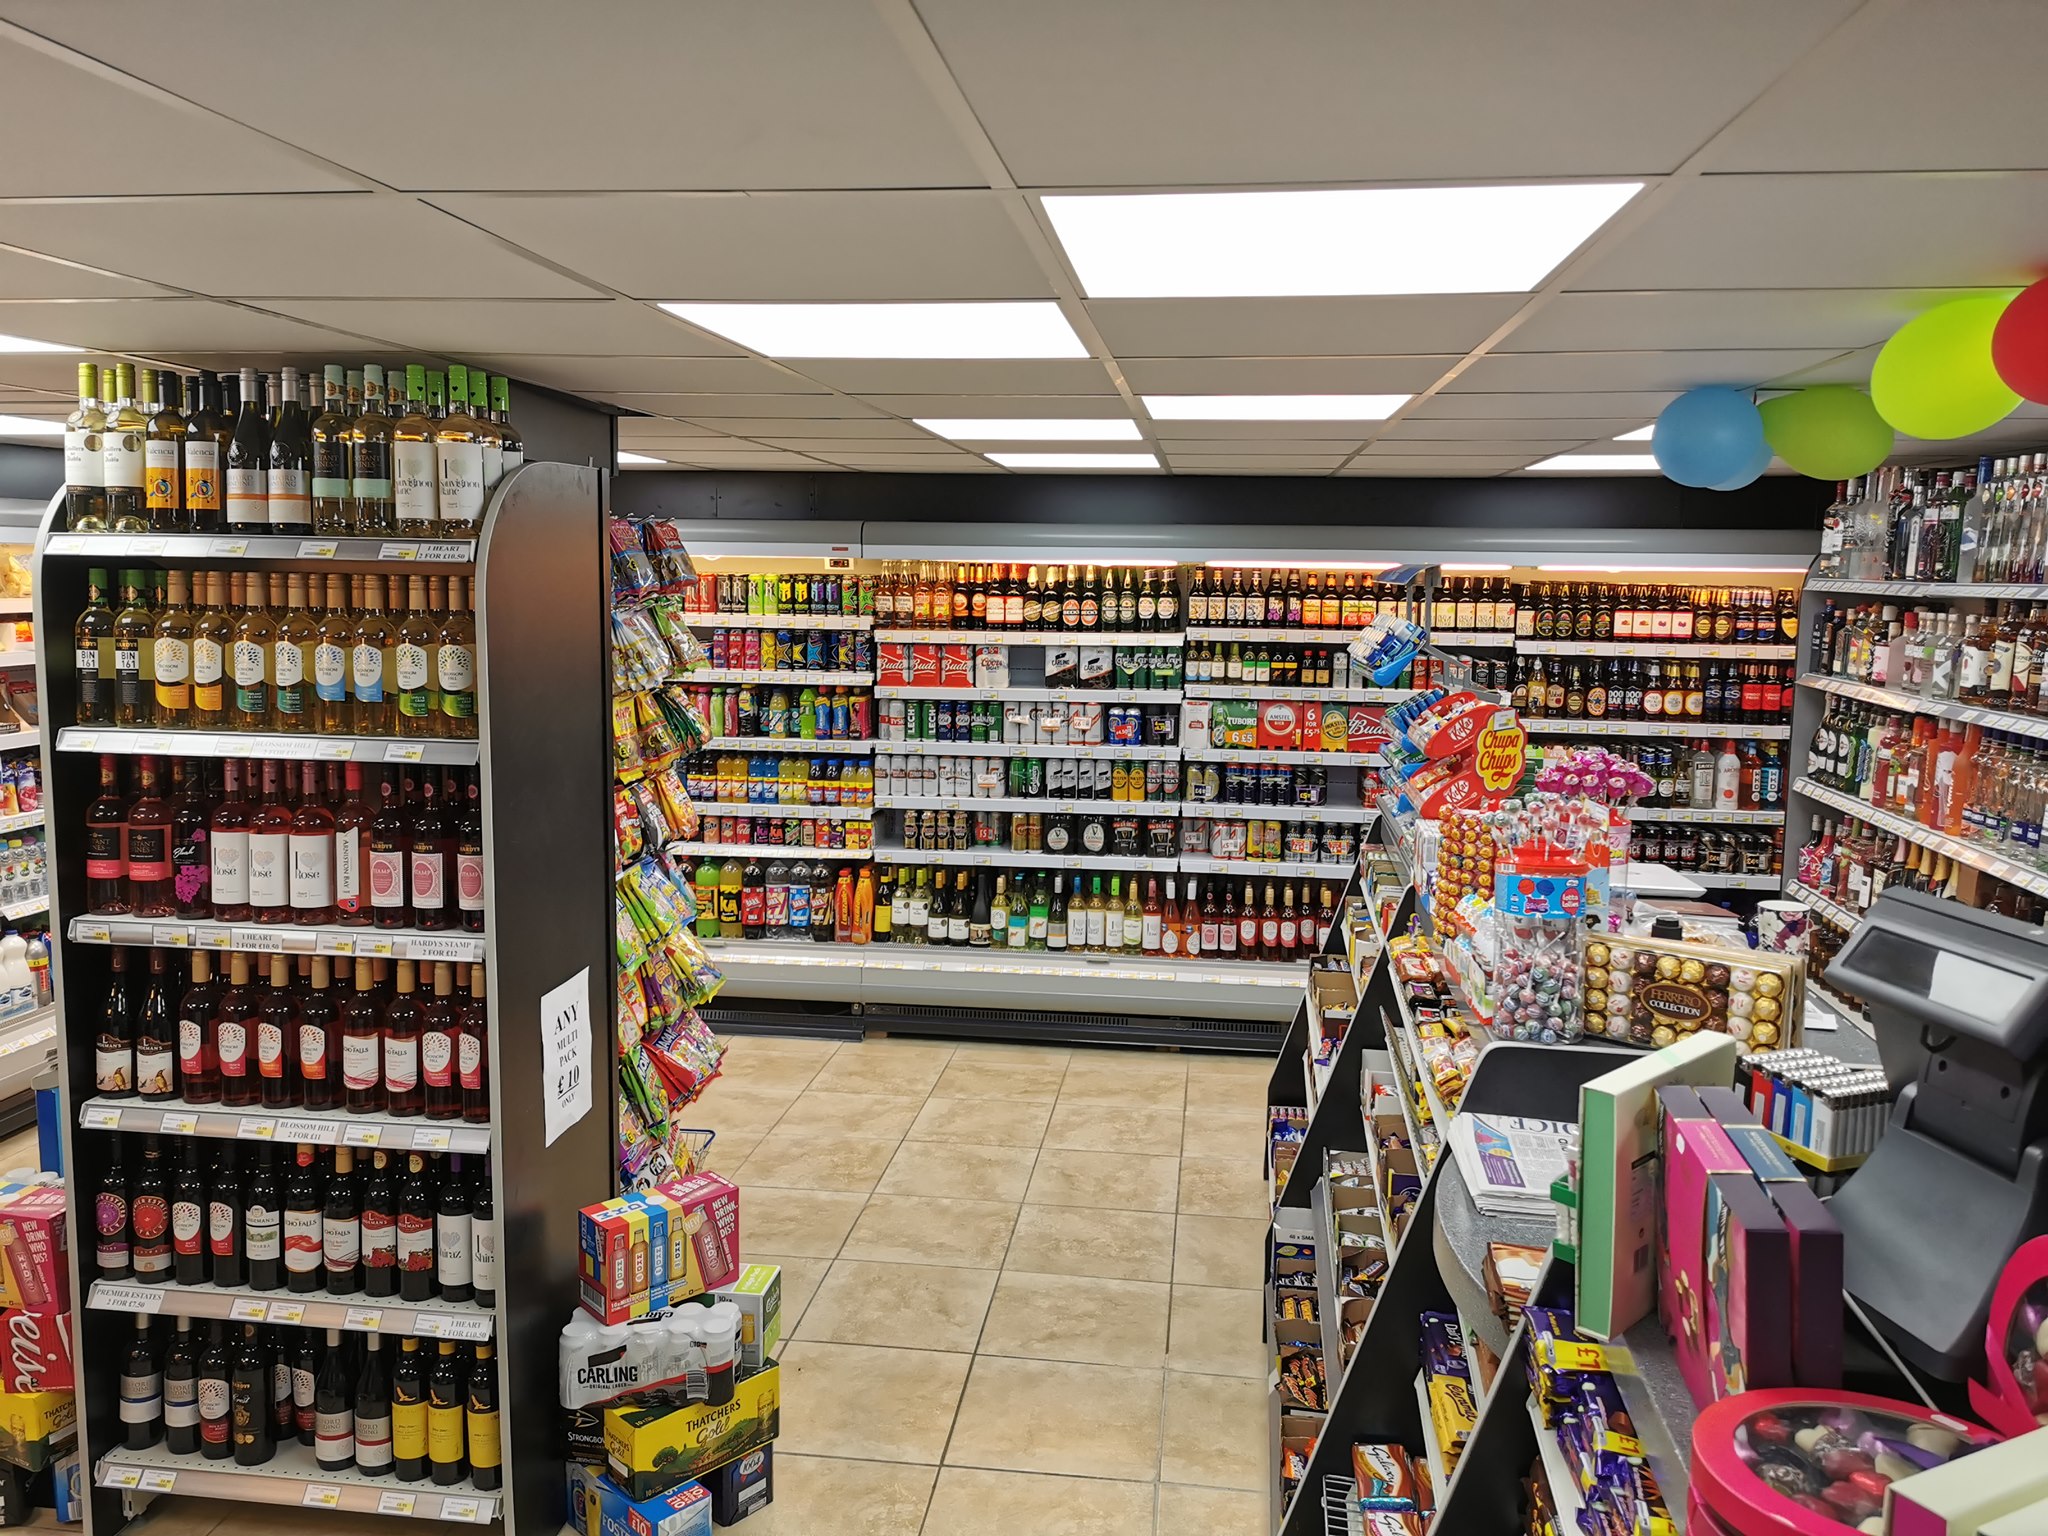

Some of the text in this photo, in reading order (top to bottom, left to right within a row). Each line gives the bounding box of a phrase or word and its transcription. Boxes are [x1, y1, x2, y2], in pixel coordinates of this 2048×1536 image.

[81, 651, 95, 660] BIN
[121, 651, 136, 660] BIN
[81, 659, 96, 668] 161
[121, 659, 136, 669] 161
[1084, 664, 1103, 672] CARLING
[1608, 690, 1624, 698] DOO
[907, 709, 915, 733] LECH
[1307, 708, 1315, 719] 6
[1227, 717, 1257, 726] TUBORG
[1483, 731, 1520, 753] Chupa
[1480, 751, 1518, 772] Chups
[410, 939, 472, 949] HARDYS STAMP
[1650, 988, 1701, 1008] FERRERO
[1649, 999, 1701, 1017] COLLECTION
[554, 1001, 579, 1035] ANY
[556, 1029, 578, 1052] MULTI
[559, 1047, 577, 1067] PACK
[561, 1092, 576, 1109] ONLY
[280, 1121, 336, 1132] BLOSSOM HILL
[712, 1195, 728, 1210] NEW
[715, 1204, 738, 1220] DRINK.
[22, 1221, 38, 1232] NEW
[684, 1216, 700, 1231] NEW
[718, 1213, 735, 1229] WHO
[25, 1231, 49, 1242] DRINK.
[720, 1223, 735, 1239] DIS?
[29, 1242, 46, 1252] WHO
[33, 1252, 48, 1264] DIS?
[96, 1289, 162, 1300] PREMIER ESTATES
[455, 1320, 481, 1329] HEART
[448, 1329, 464, 1337] FOR
[577, 1366, 638, 1385] CARLING
[43, 1399, 76, 1420] THATCH
[1445, 1384, 1478, 1422] Caramel
[686, 1400, 741, 1433] THATCHERS
[696, 1417, 730, 1446] Gold
[1371, 1444, 1396, 1488] Galaxy
